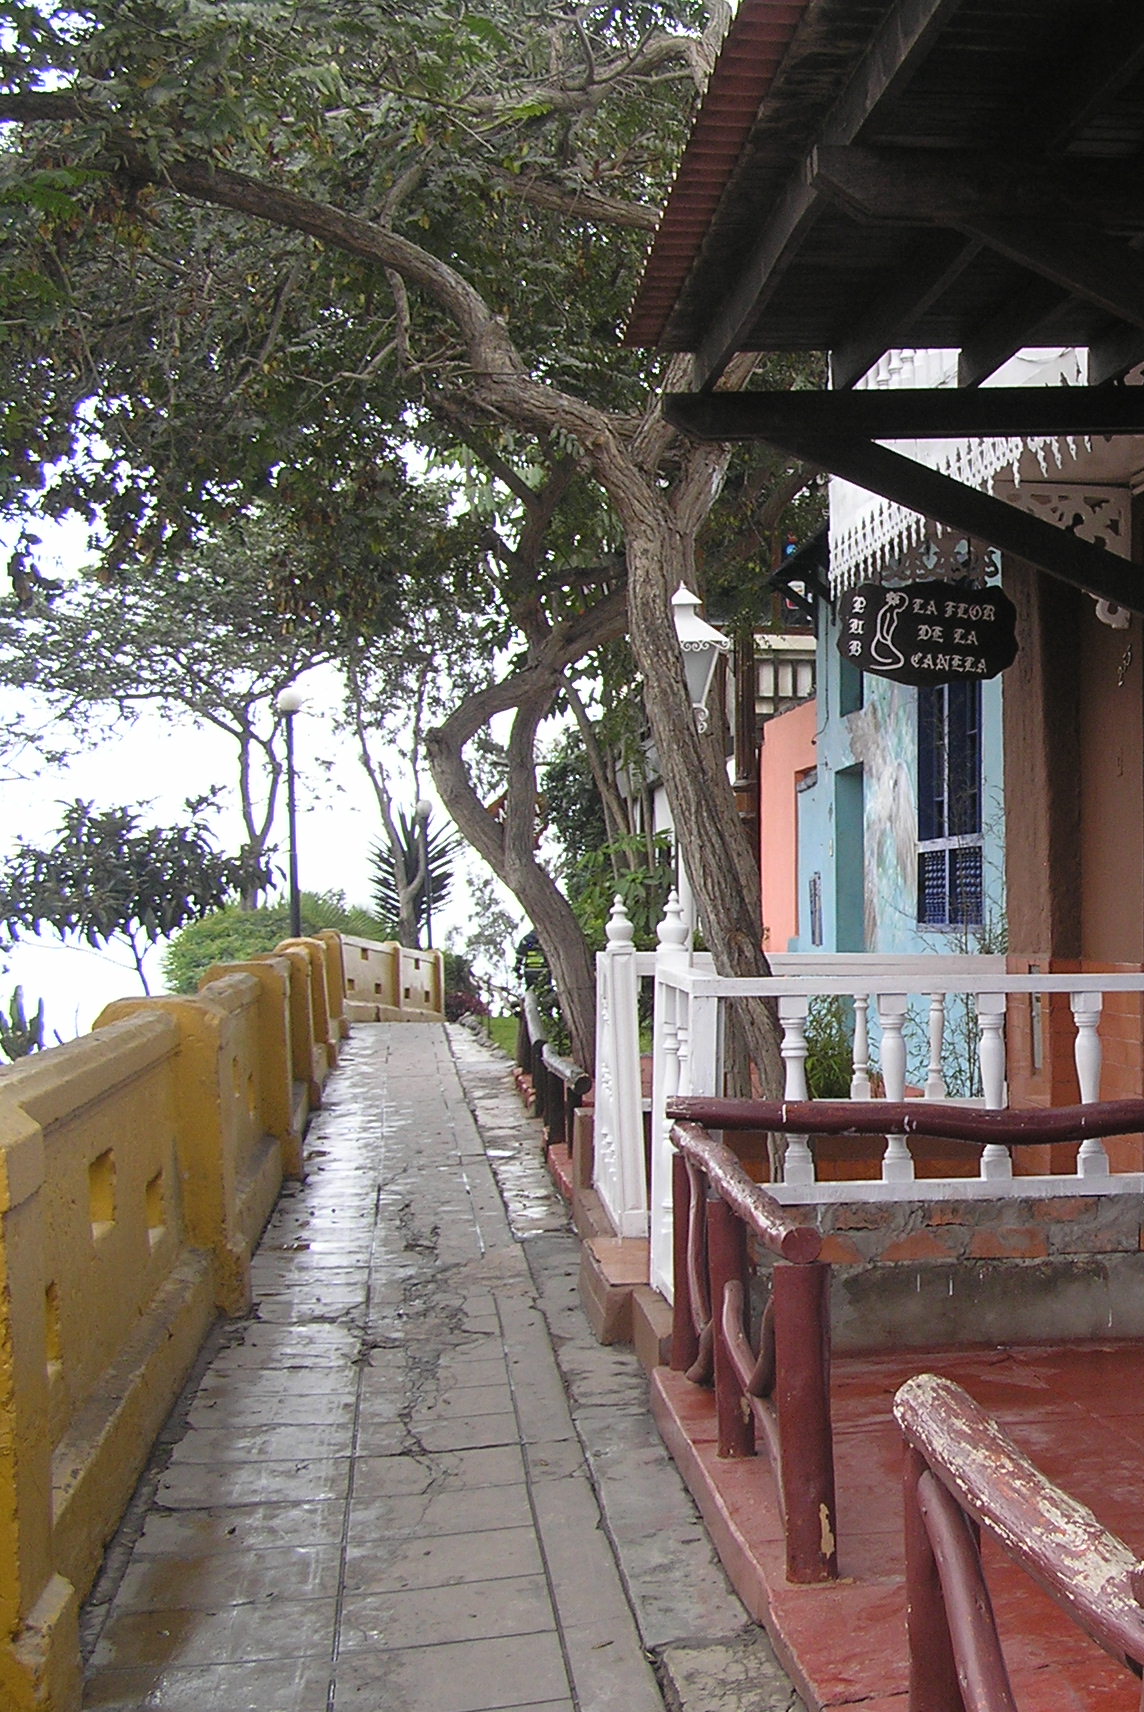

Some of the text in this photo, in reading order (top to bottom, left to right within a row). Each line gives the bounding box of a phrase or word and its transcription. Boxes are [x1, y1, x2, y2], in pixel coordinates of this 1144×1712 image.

[912, 598, 996, 622] LA FLOR
[916, 624, 979, 646] DE LA
[910, 652, 988, 674] CANELA
